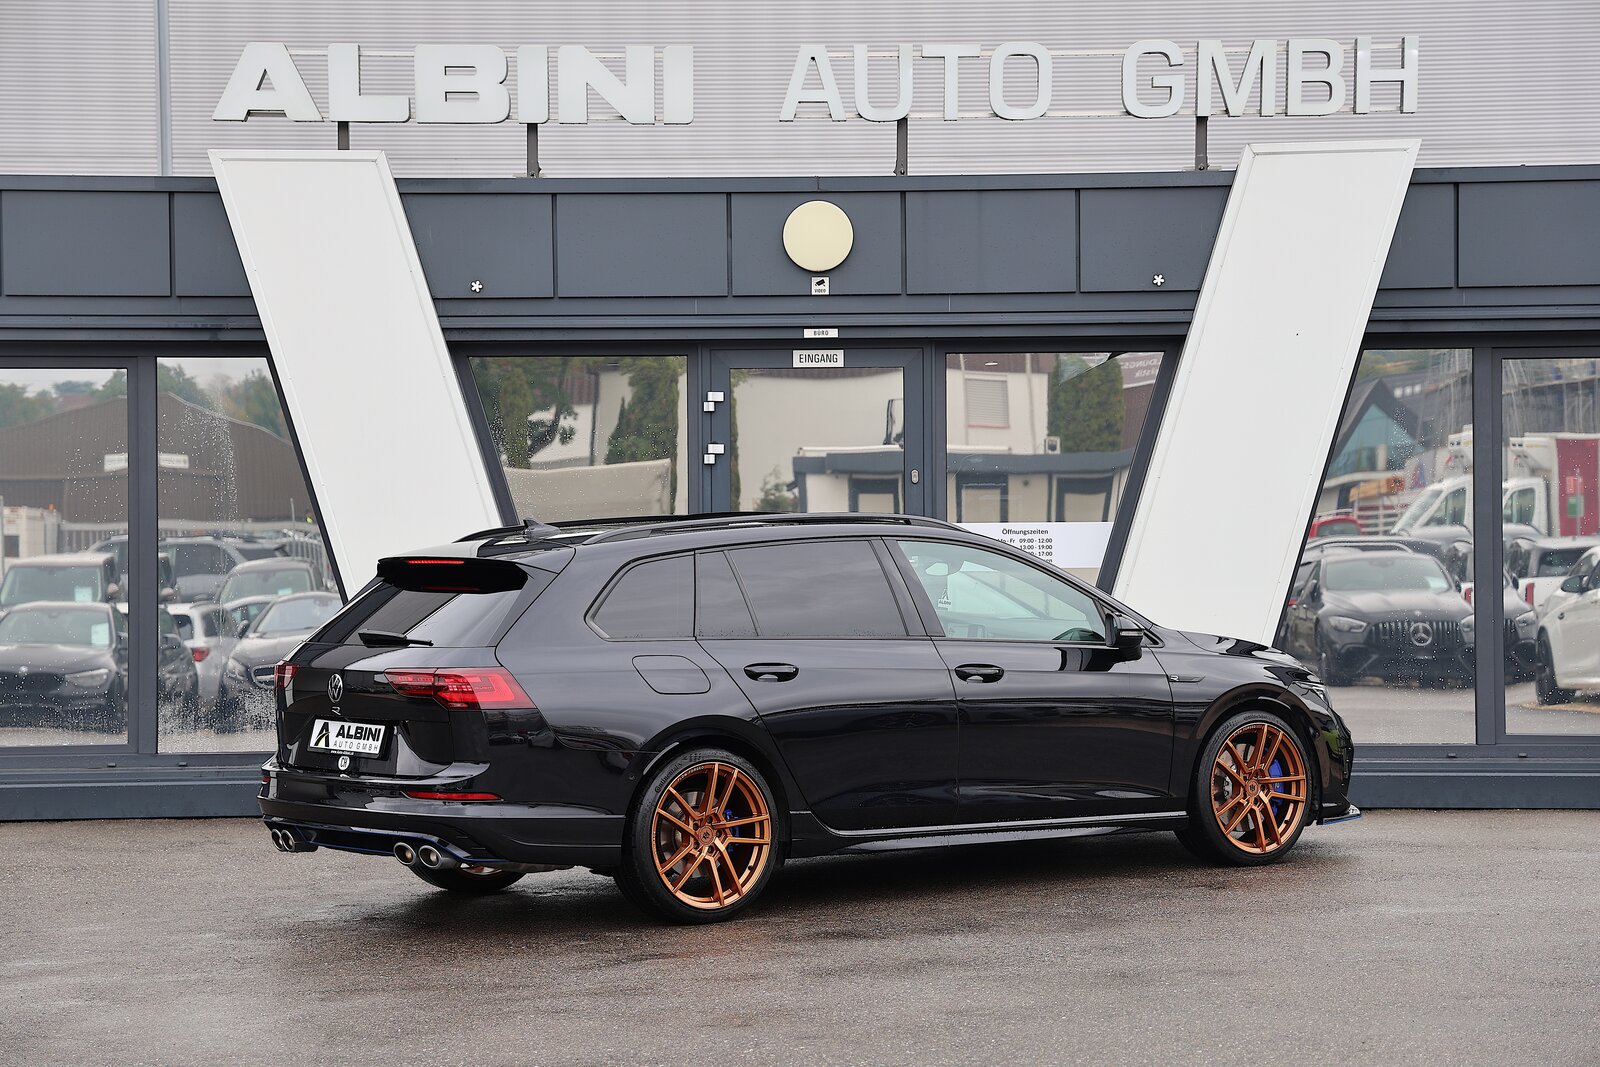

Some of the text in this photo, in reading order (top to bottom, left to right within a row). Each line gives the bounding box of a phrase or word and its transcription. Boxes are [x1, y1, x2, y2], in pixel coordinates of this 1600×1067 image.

[212, 34, 1420, 125] ALBINI AUTO GMBH
[799, 353, 838, 363] EINGANG
[1001, 528, 1049, 536] Öffnungszeiten
[335, 725, 381, 742] ALBINI
[333, 740, 378, 752] AUTO GMBH
[340, 757, 347, 768] CH
